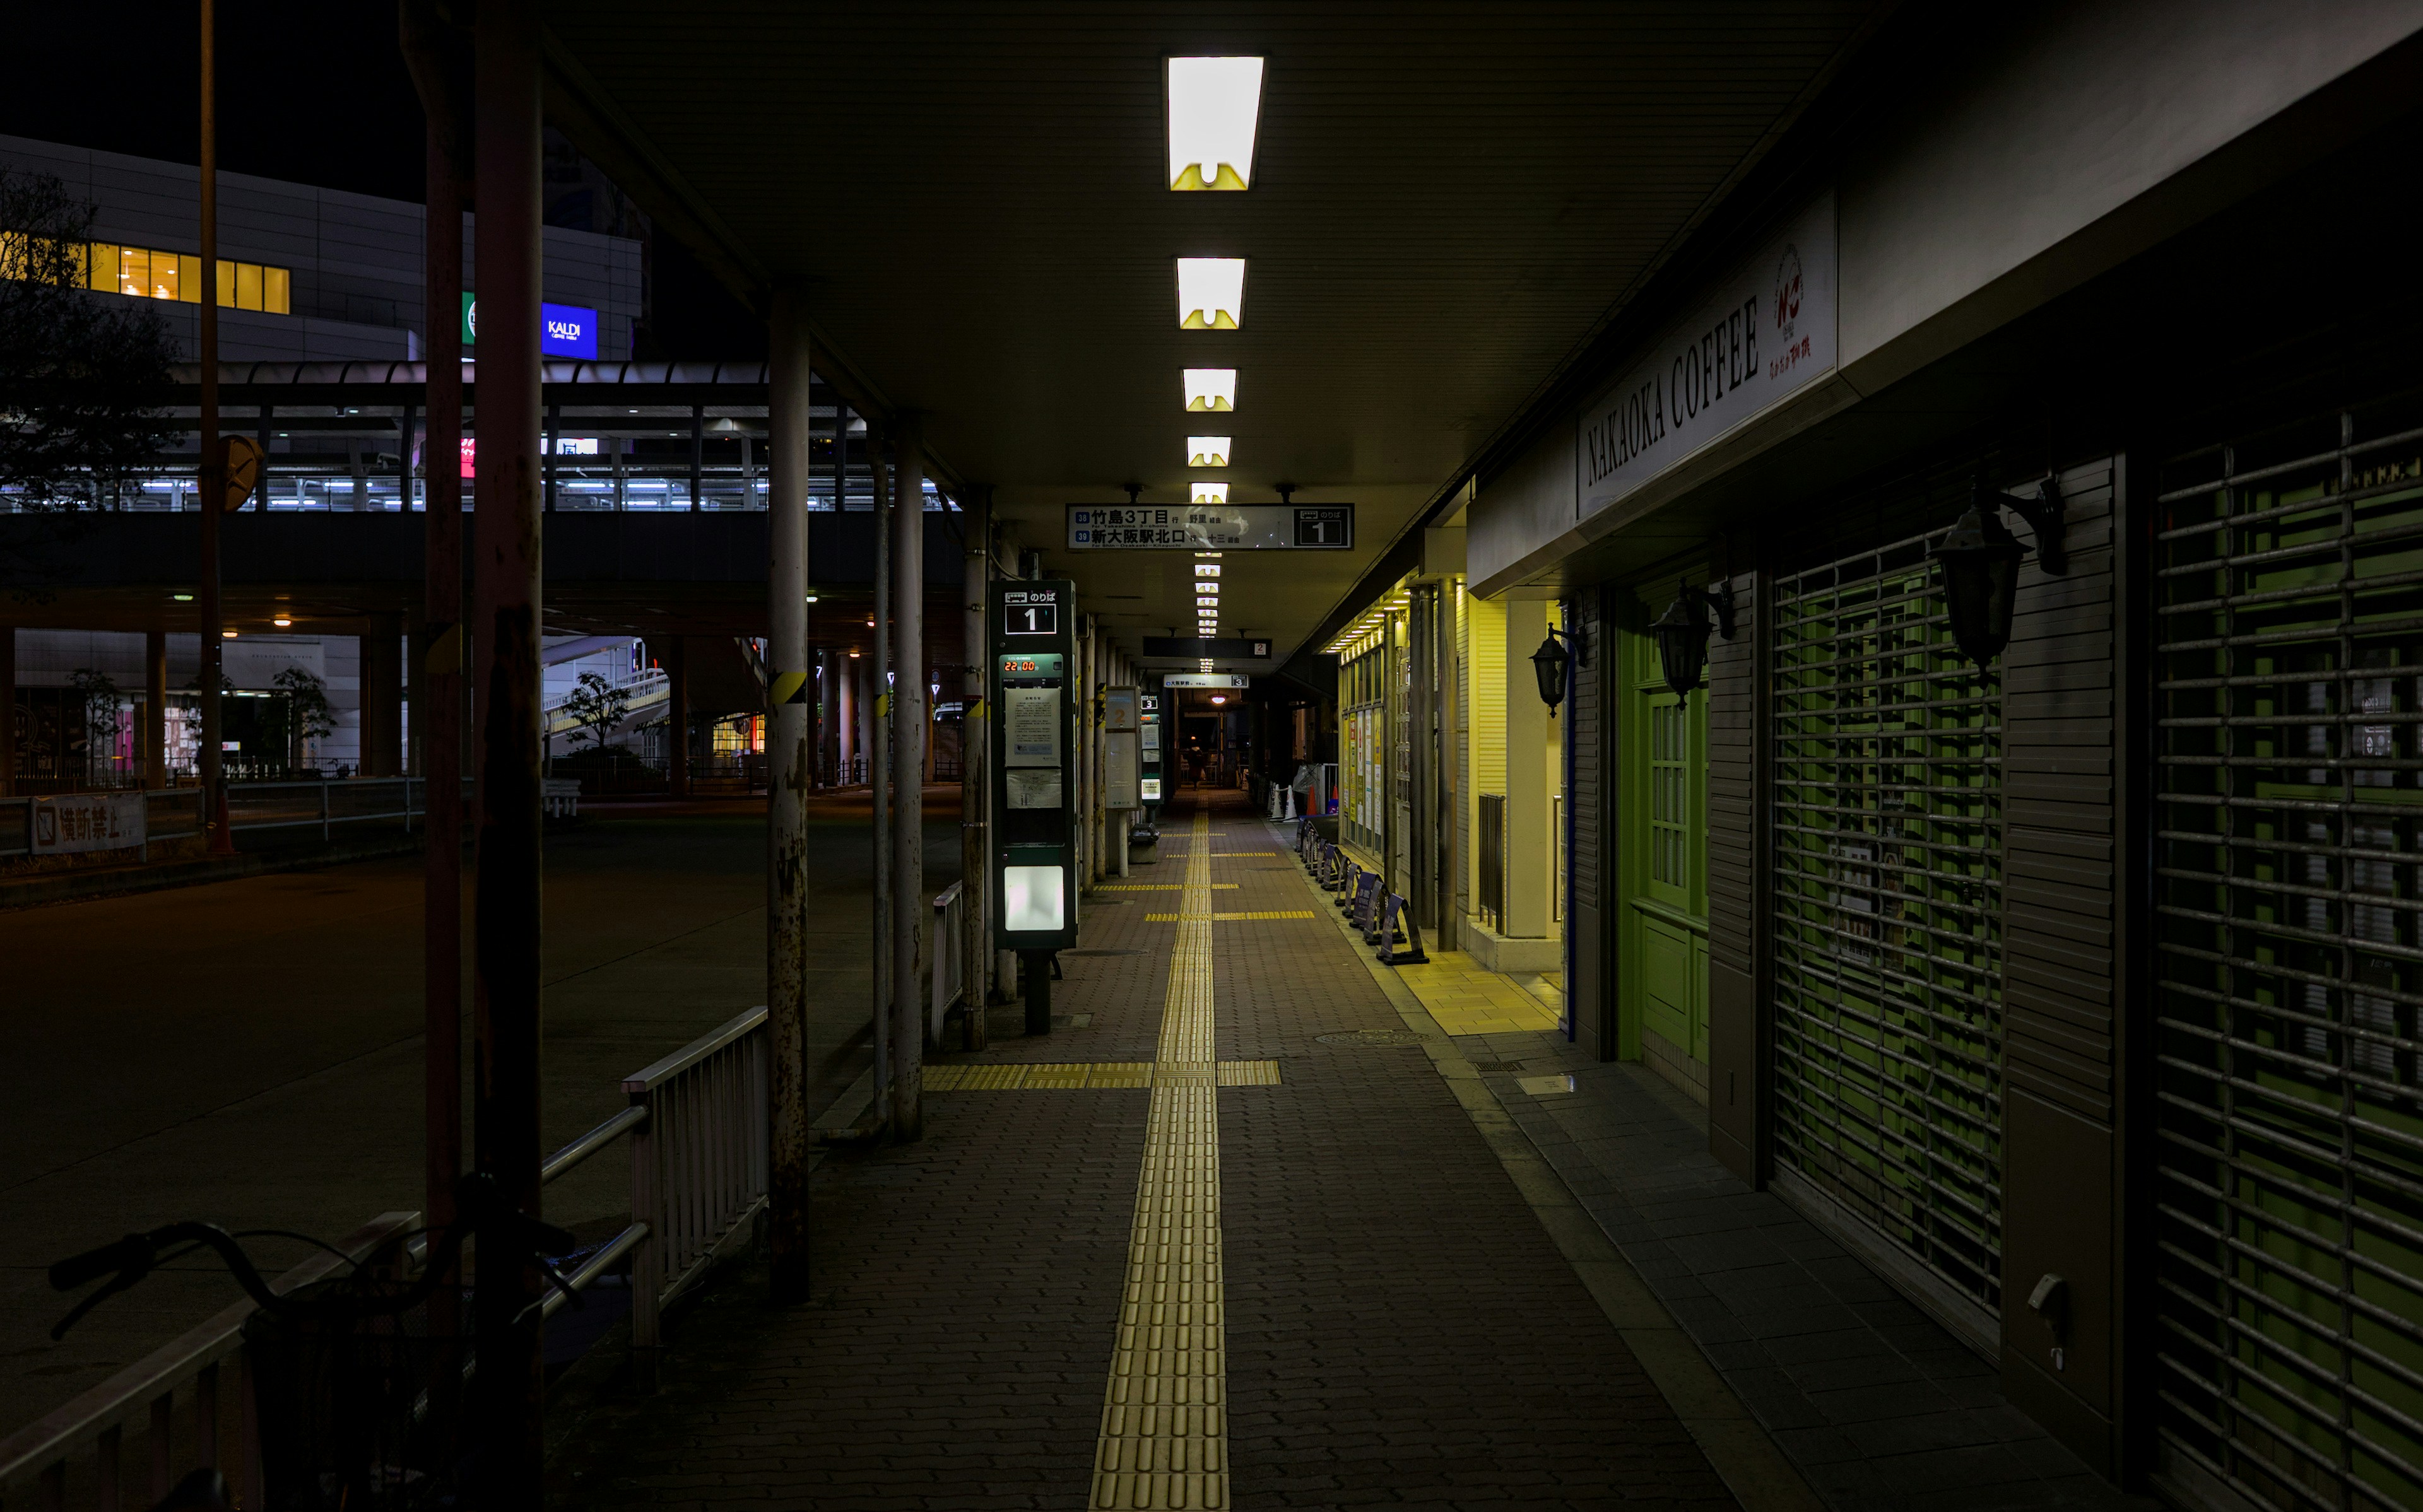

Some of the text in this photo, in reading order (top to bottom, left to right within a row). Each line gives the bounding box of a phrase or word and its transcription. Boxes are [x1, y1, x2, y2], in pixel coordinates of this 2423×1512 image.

[548, 320, 581, 336] KALDI
[1588, 295, 1759, 487] NAKAOKA COFFEE
[1078, 514, 1087, 522] 38
[1091, 510, 1167, 524] 竹島3丁目
[1190, 514, 1207, 524] 野里
[1078, 532, 1088, 541] 39
[1091, 529, 1185, 544] 新大阪駅北口
[1208, 534, 1225, 543] 十三
[1312, 522, 1324, 543] 1
[1030, 593, 1056, 602] のりば
[1024, 608, 1035, 631] 1
[1235, 678, 1242, 686] 3
[1146, 700, 1152, 708] 3
[1114, 709, 1126, 724] 2
[59, 806, 120, 841] 横断禁止
